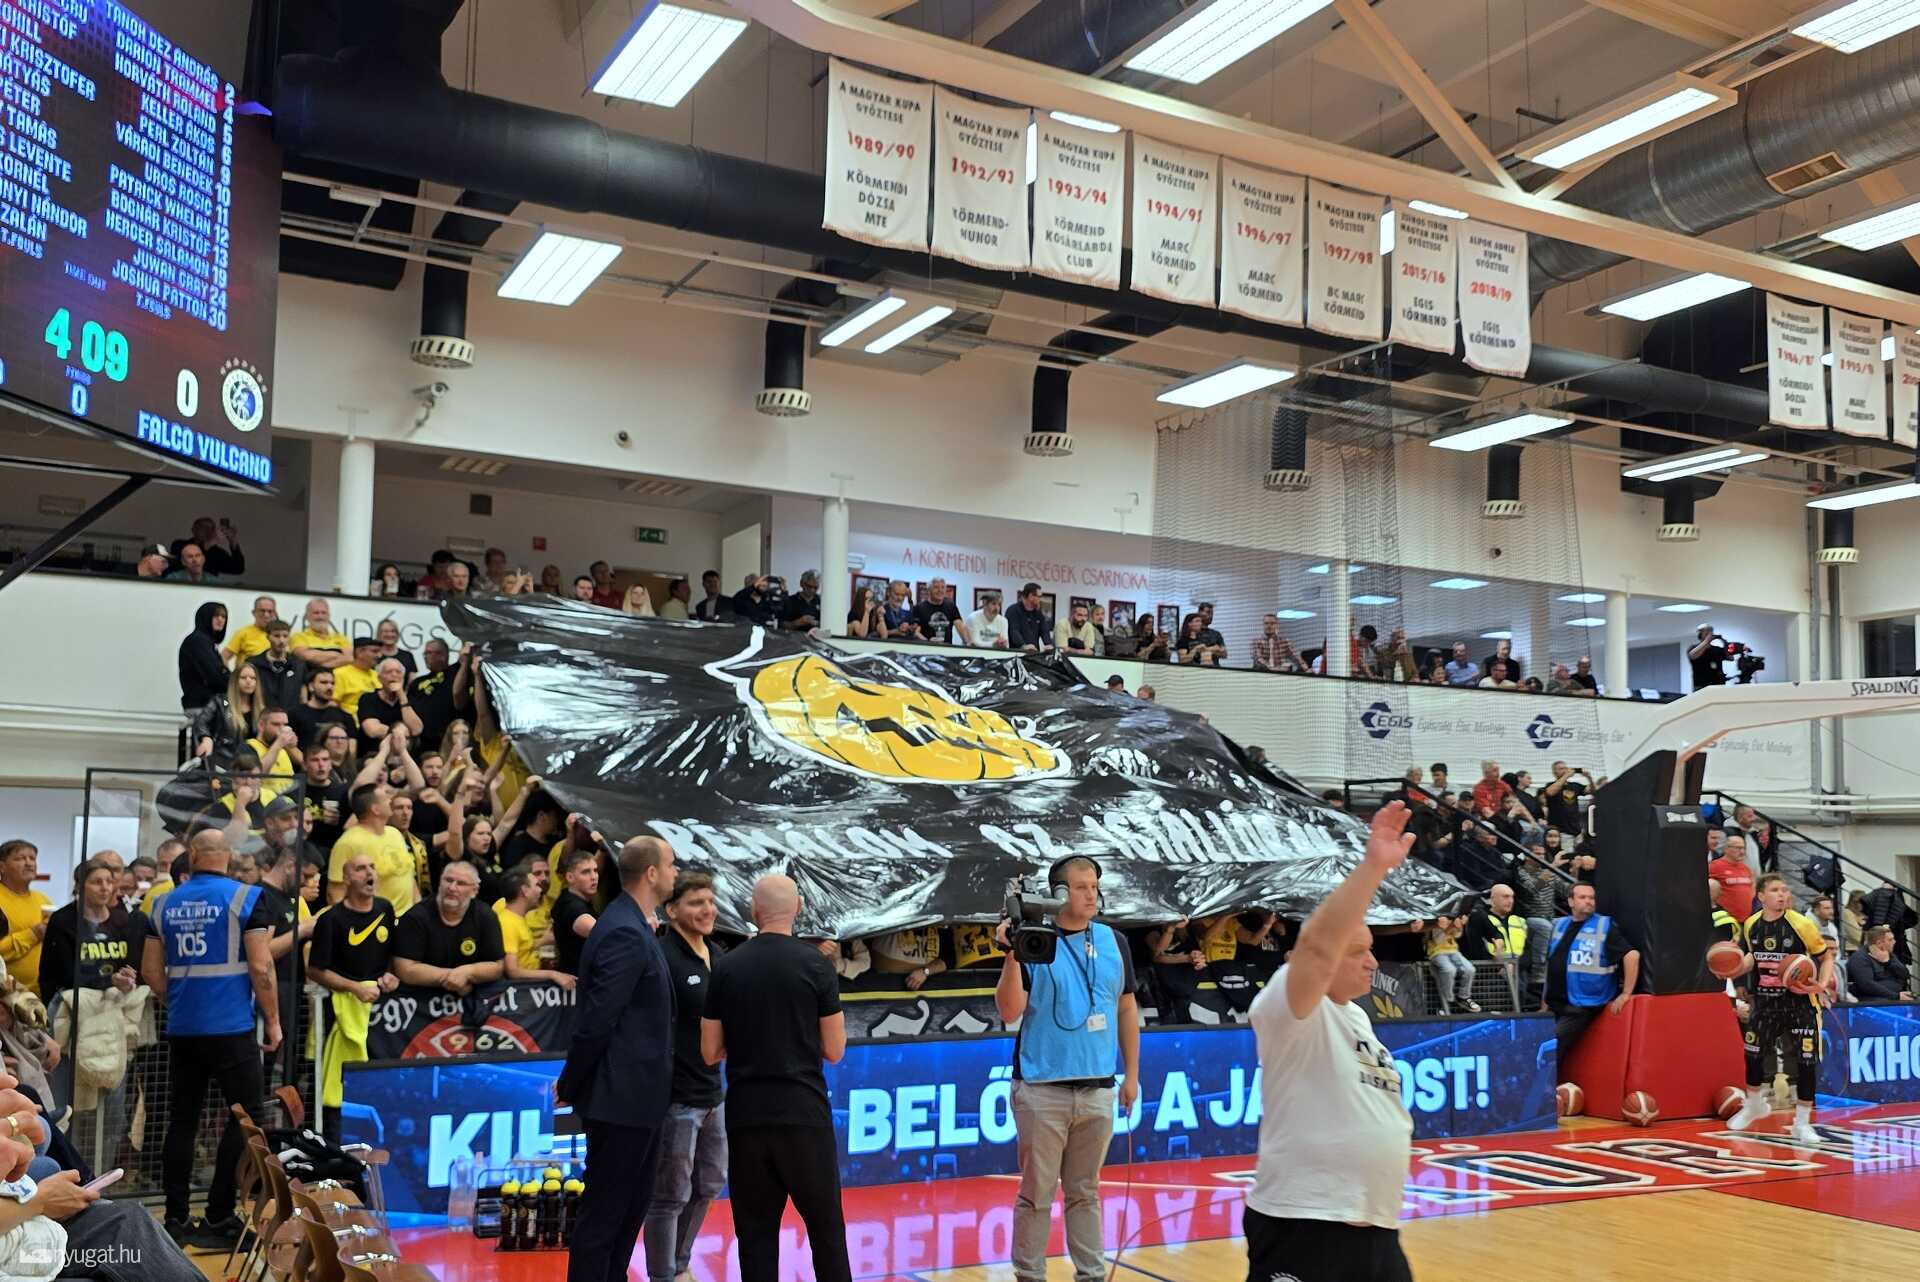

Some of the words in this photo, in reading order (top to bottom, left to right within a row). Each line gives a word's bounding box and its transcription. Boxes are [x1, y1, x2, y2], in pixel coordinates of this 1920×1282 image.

[0, 50, 50, 96] ÁTYÁS
[10, 32, 96, 101] KRISZTOFER
[225, 82, 235, 106] 2
[839, 82, 847, 92] A
[850, 85, 893, 106] MAGYAR
[895, 97, 921, 112] KUPA
[173, 92, 216, 134] ROLAND
[223, 123, 233, 145] 5
[223, 106, 233, 124] 4
[953, 114, 993, 135] MAGYAR
[996, 128, 1020, 140] KUPA
[139, 114, 169, 147] PERL
[141, 91, 183, 135] KELLER
[222, 145, 233, 166] 6
[9, 131, 71, 182] LEVENTE
[848, 130, 916, 160] 1989/90
[1053, 136, 1090, 156] MAGYAR
[1093, 148, 1116, 161] KUPA
[163, 151, 214, 196] BENEDEK
[215, 182, 231, 208] 10
[952, 156, 1015, 185] 1992/93
[1151, 157, 1186, 176] MAGYAR
[1188, 167, 1210, 181] KUPA
[846, 169, 908, 196] KÖRMENDI
[1048, 177, 1108, 205] 1993/94
[1239, 182, 1273, 201] MAGYAR
[110, 163, 162, 210] PATRICK
[165, 195, 212, 236] WHELAN
[214, 223, 229, 249] 12
[859, 191, 896, 211] DÓZSA
[1324, 202, 1355, 220] MAGYAR
[215, 204, 229, 227] 11
[864, 211, 888, 228] MTE
[1054, 215, 1106, 237] KÖRMEND
[1160, 237, 1190, 255] MARC
[1237, 221, 1293, 246] 1996/97
[213, 243, 229, 269] 13
[1066, 254, 1094, 269] CLUB
[1323, 240, 1374, 266] 1997/98
[133, 248, 176, 285] JUWAN
[179, 275, 210, 301] GRAY
[209, 284, 227, 311] 24
[212, 265, 228, 290] 19
[1248, 269, 1276, 286] MARC
[1401, 261, 1447, 285] 2015/16
[112, 259, 161, 298] JOSHUA
[163, 281, 209, 322] PATTON
[207, 305, 227, 331] 30
[1326, 285, 1340, 300] BC
[1413, 296, 1435, 312] EGIS
[1470, 280, 1513, 303] 2018/19
[71, 382, 89, 417] 0
[177, 369, 199, 418] 0
[137, 409, 195, 457] FALCO
[197, 432, 272, 485] VULCANO
[903, 547, 912, 564] A
[1851, 678, 1919, 697] SPALDING
[1377, 715, 1414, 729] EGIS
[1540, 725, 1575, 740] EGIS
[80, 940, 128, 960] FALCO
[176, 932, 207, 958] 105
[1570, 950, 1593, 966] 106
[1153, 1071, 1199, 1133] A
